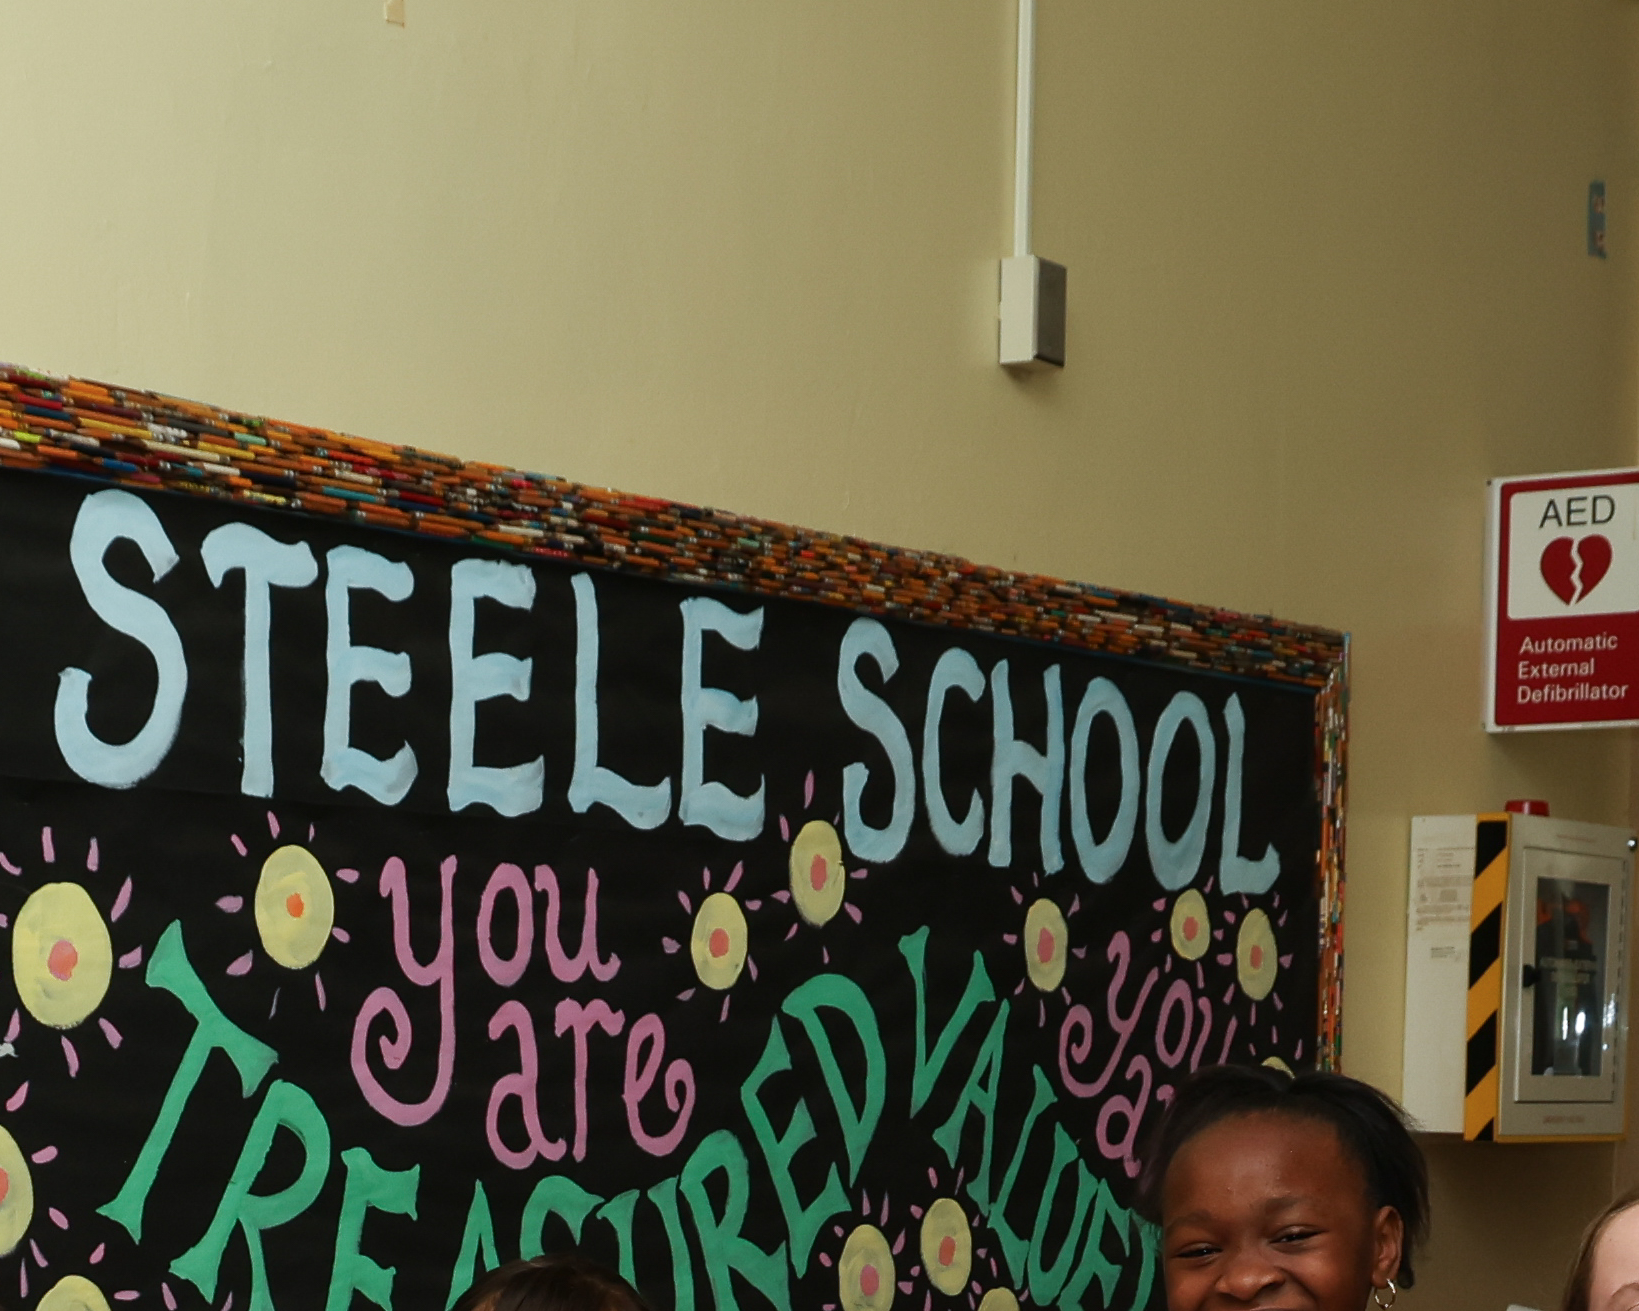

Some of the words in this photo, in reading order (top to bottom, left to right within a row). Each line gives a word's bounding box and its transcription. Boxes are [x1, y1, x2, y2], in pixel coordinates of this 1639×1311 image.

[1539, 494, 1616, 529] AED
[1519, 631, 1619, 654] Automatic
[1518, 658, 1596, 680] External
[54, 489, 763, 841] STEELE
[837, 617, 1281, 896] SCHOOL
[1517, 682, 1629, 704] Defibrillator
[351, 854, 620, 1127] you
[485, 997, 695, 1169] are
